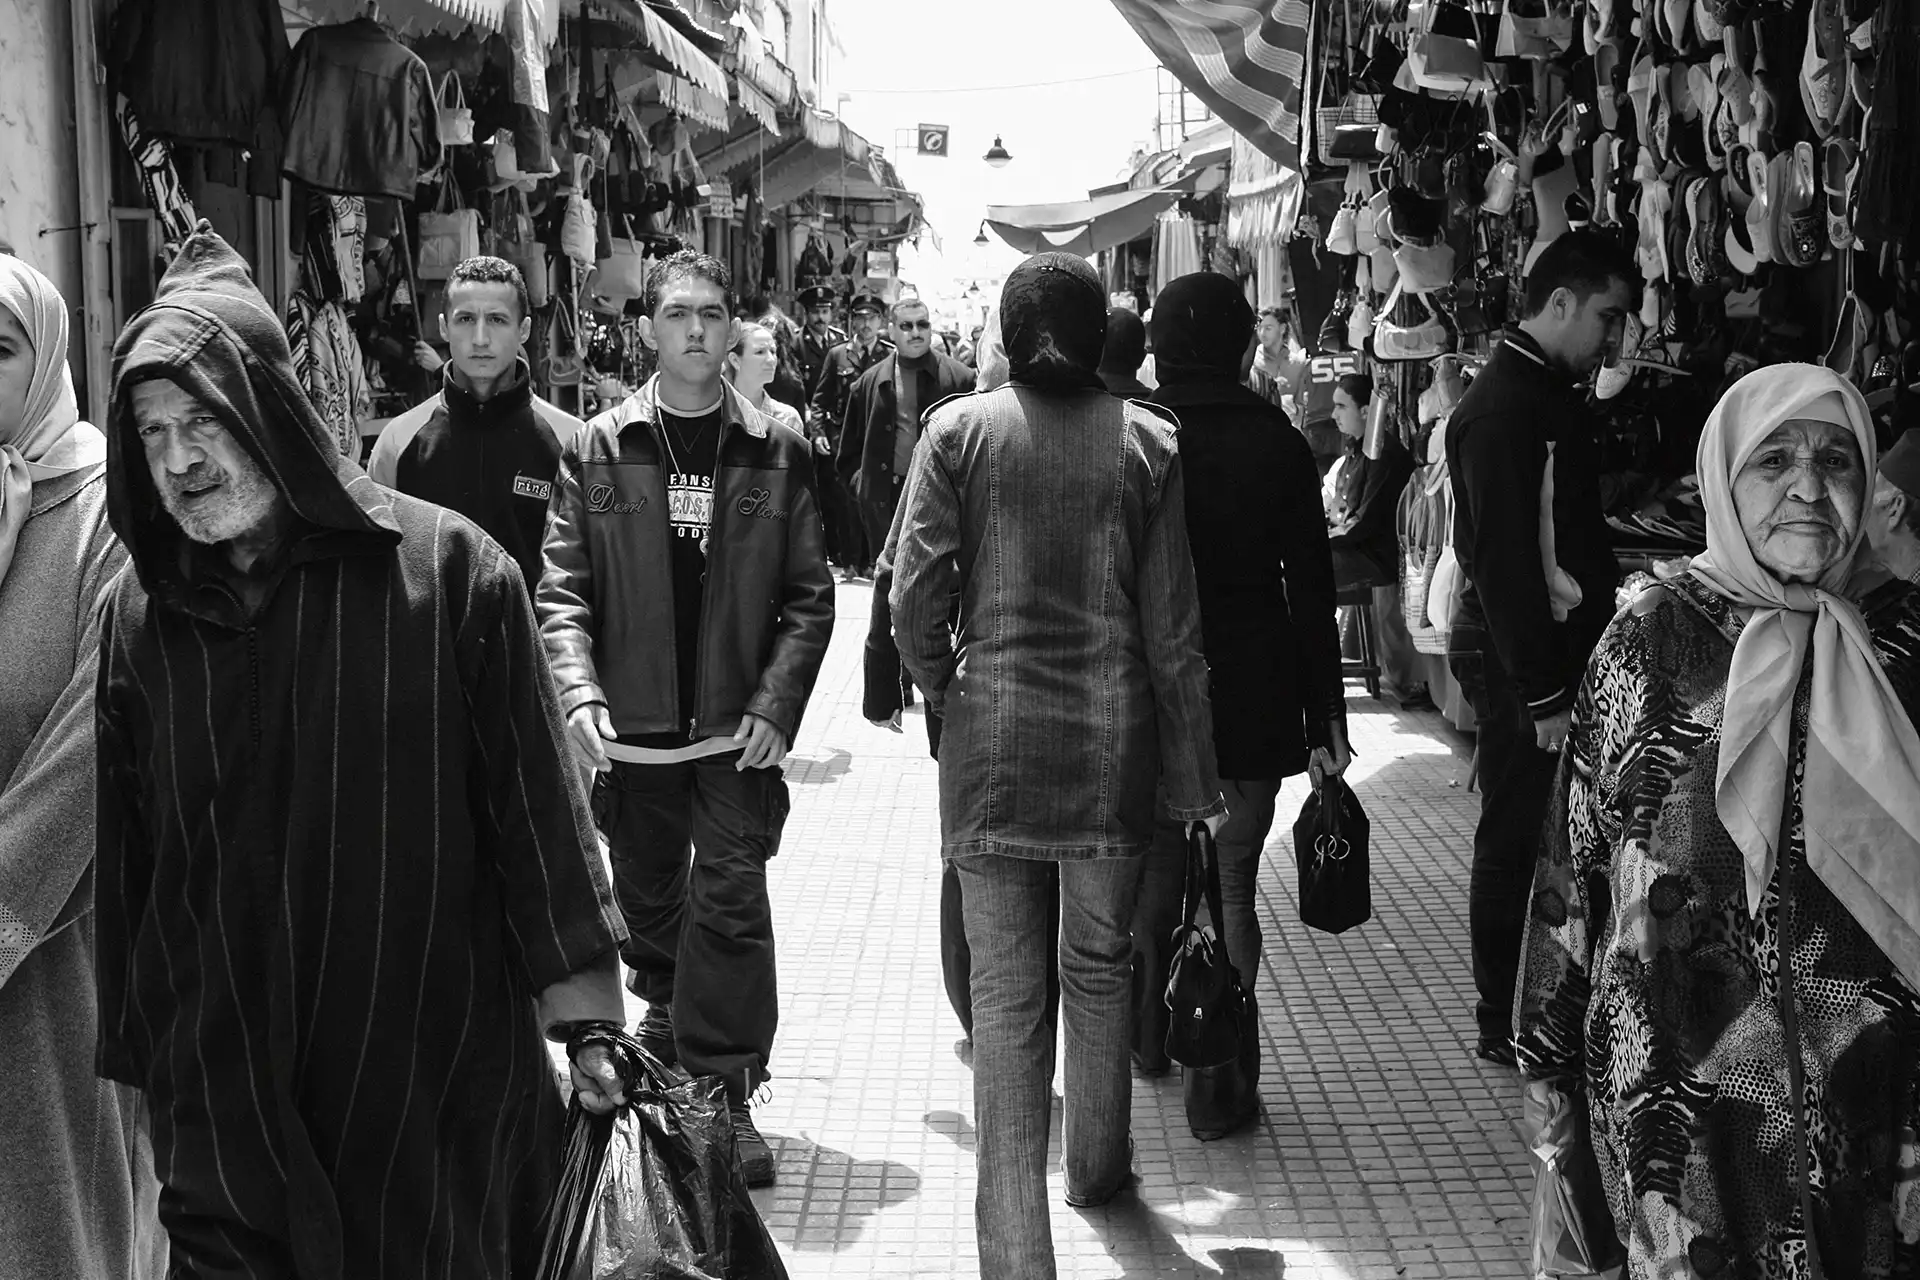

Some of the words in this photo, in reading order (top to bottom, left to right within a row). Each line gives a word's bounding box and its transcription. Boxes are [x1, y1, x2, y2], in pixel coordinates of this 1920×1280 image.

[517, 480, 549, 497] ring
[670, 473, 710, 487] FANS
[587, 483, 648, 513] Desert
